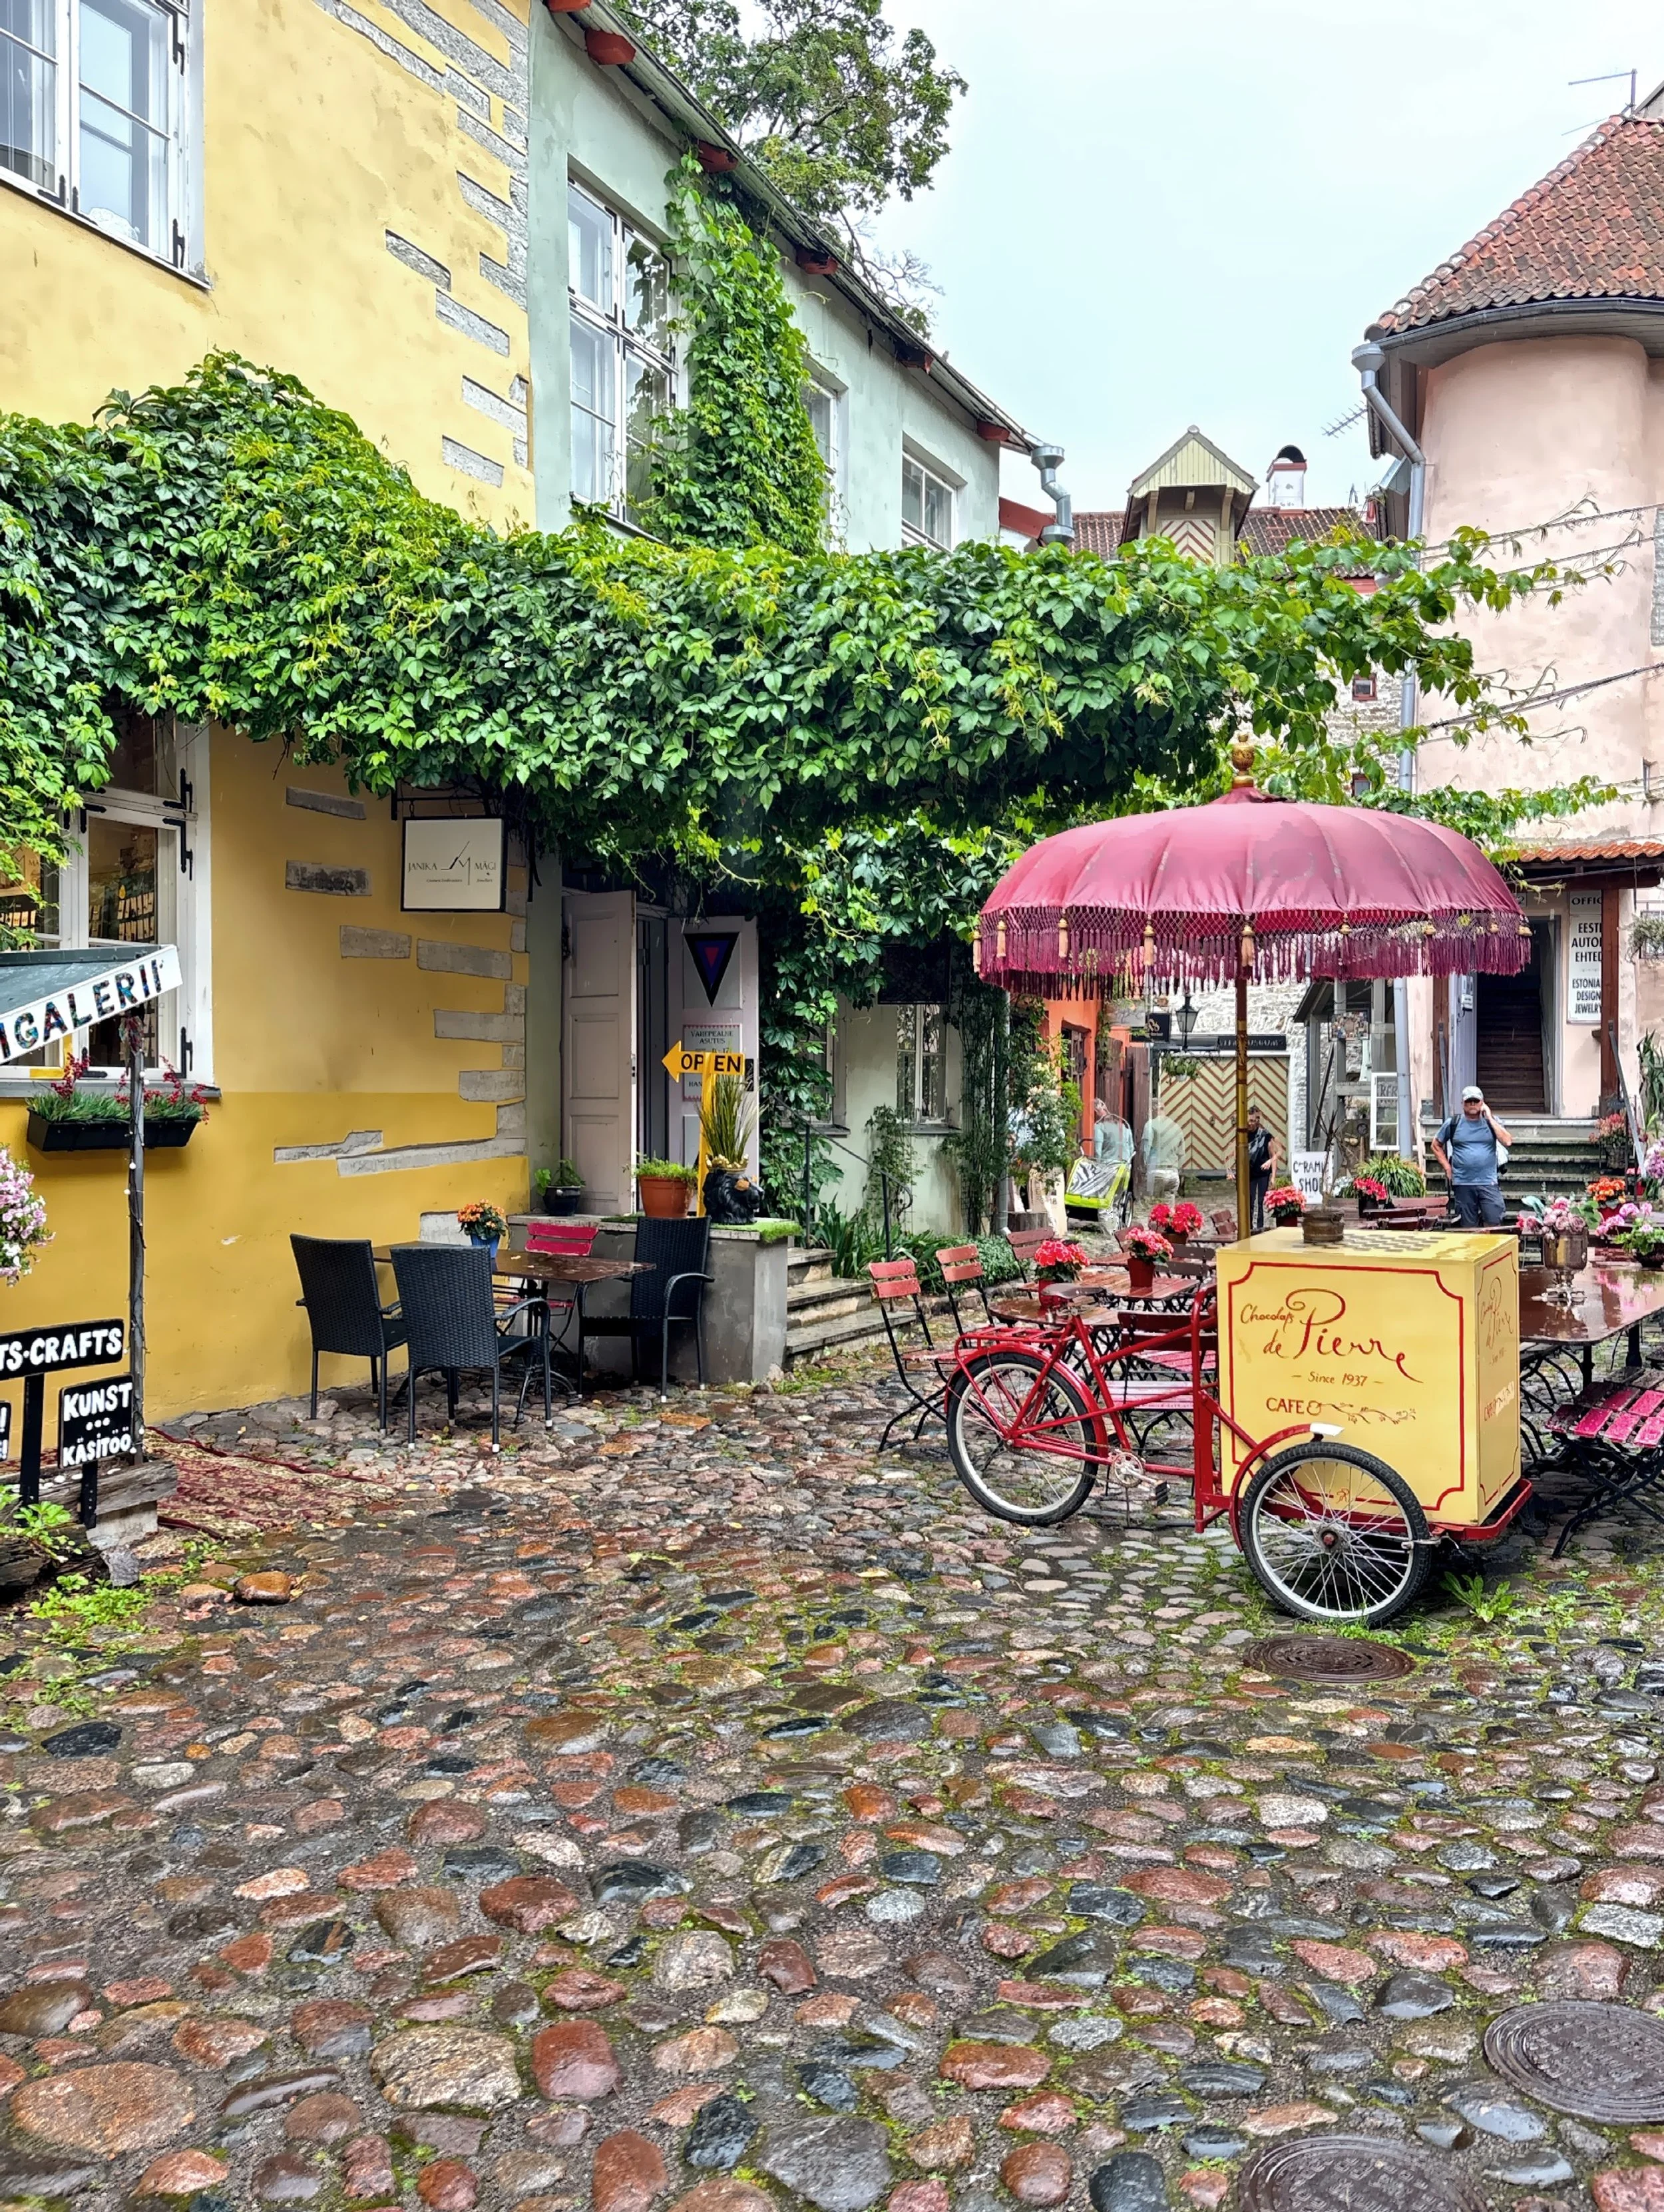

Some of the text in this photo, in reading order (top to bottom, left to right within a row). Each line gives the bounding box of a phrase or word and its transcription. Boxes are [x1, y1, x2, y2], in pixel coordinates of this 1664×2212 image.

[407, 862, 438, 873] JANIKA
[1571, 897, 1602, 905] OFFIC
[1572, 978, 1601, 989] ESTONIA
[681, 1053, 741, 1073] OPEN
[1298, 1177, 1322, 1193] SHO
[1263, 1329, 1289, 1359] de
[1285, 1287, 1424, 1383] Pierre
[1307, 1371, 1368, 1387] Since 1937
[63, 1382, 133, 1422] KUNST
[1265, 1397, 1305, 1415] CAFE
